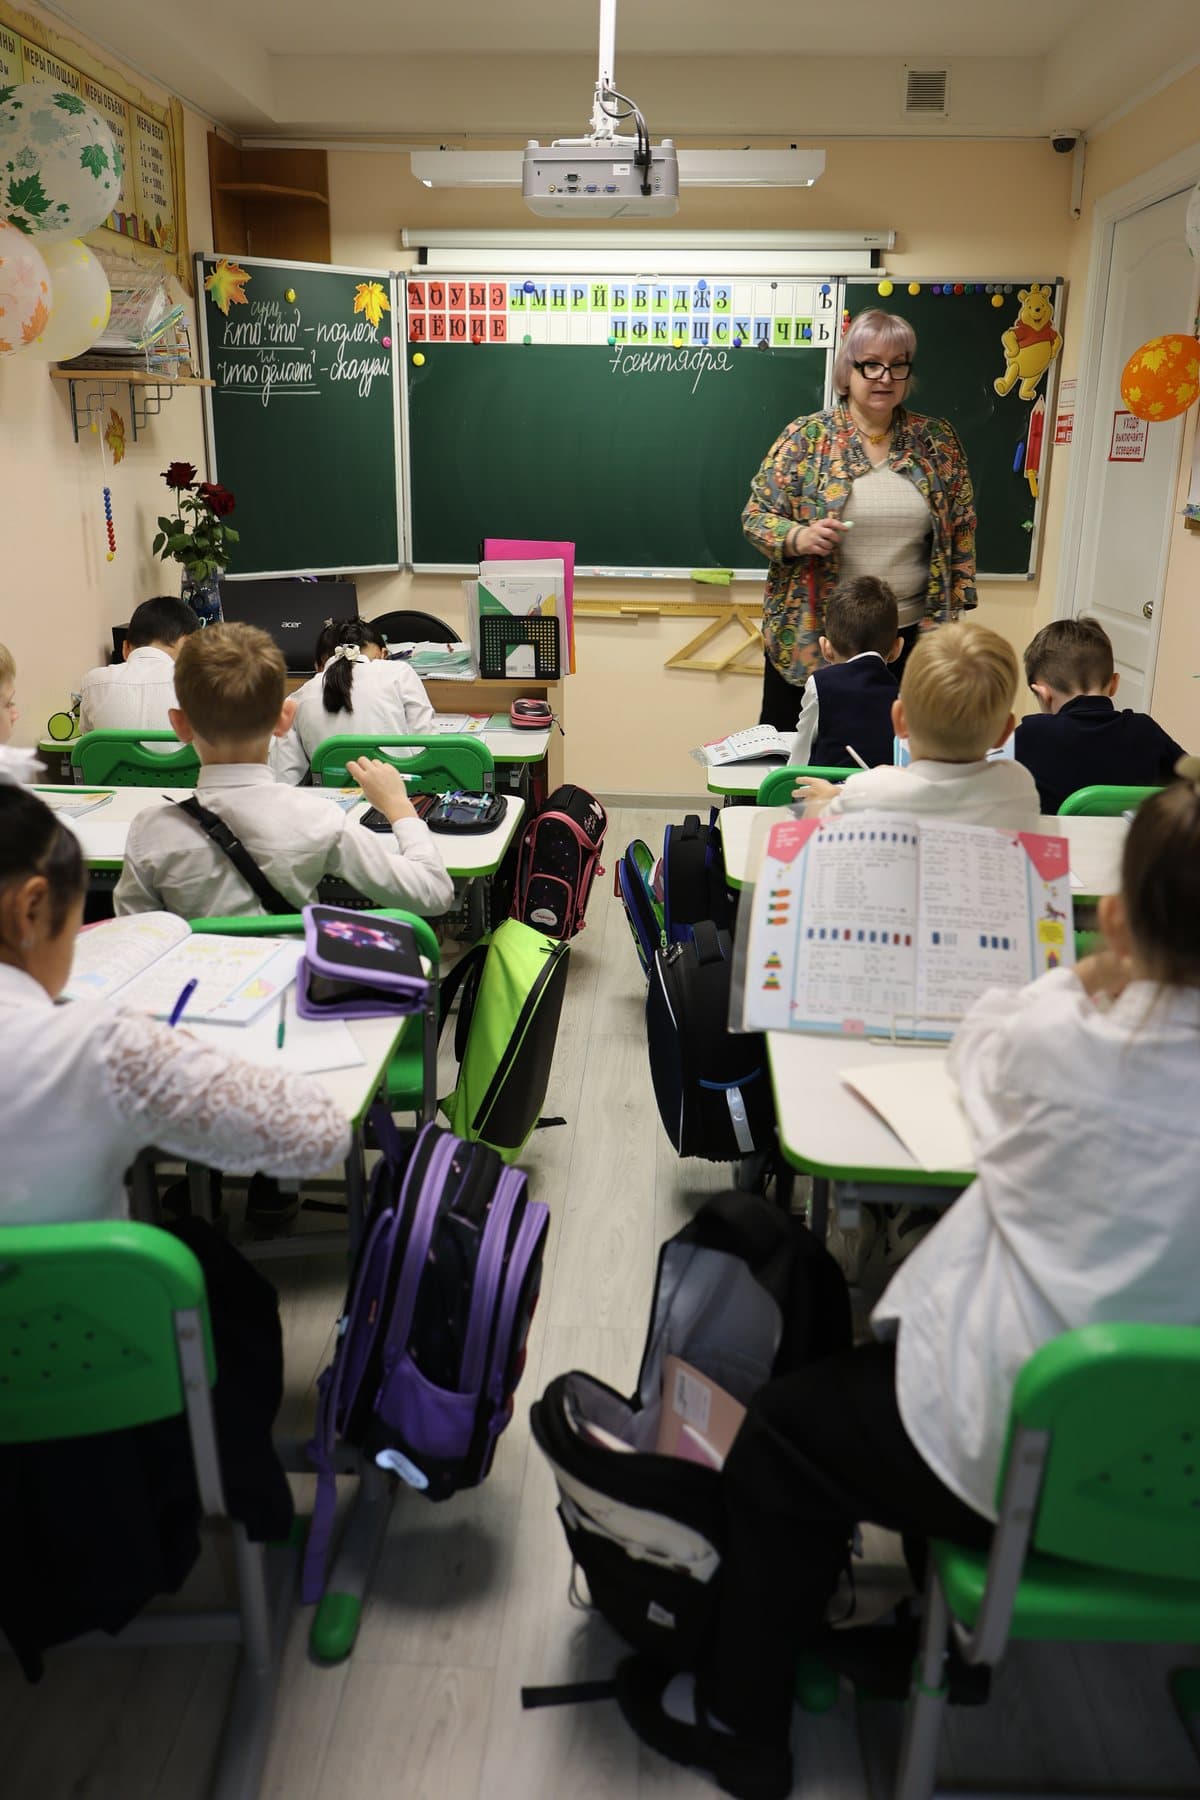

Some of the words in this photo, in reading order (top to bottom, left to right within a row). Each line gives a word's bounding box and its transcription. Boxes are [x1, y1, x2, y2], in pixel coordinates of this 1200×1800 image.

[24, 45, 46, 73] МЕРЫ
[46, 59, 80, 93] ПЛОЩАДИ
[85, 82, 103, 105] МЕРЫ
[103, 94, 127, 119] ОБЪЕМА
[136, 114, 152, 134] МЕРЫ
[151, 123, 164, 141] ВЕСА
[411, 288, 424, 306] А
[430, 288, 443, 306] О
[451, 288, 465, 306] У
[469, 288, 487, 306] Ы
[492, 288, 504, 306] Э
[511, 288, 525, 306] Л
[532, 289, 547, 306] М
[552, 289, 566, 307] Н
[573, 289, 585, 307] Р
[594, 285, 606, 307] Й
[614, 289, 626, 307] Б
[635, 290, 647, 308] В
[655, 290, 667, 308] Г
[674, 290, 688, 312] Д
[693, 289, 711, 309] Ж
[716, 290, 728, 309] З
[818, 292, 833, 309] Ъ
[412, 319, 425, 336] Я
[432, 314, 444, 336] Ё
[449, 318, 467, 336] Ю
[472, 319, 485, 337] И
[493, 319, 505, 337] Е
[613, 321, 627, 339] П
[632, 321, 648, 339] Ф
[655, 321, 667, 339] К
[675, 321, 688, 339] Т
[692, 321, 710, 340] Ш
[716, 322, 728, 340] С
[736, 323, 749, 341] Х
[756, 323, 769, 342] Ц
[777, 323, 789, 341] Ч
[818, 323, 830, 341] Ь
[609, 345, 624, 373] 7
[622, 347, 734, 394] сентября
[281, 621, 302, 629] acer
